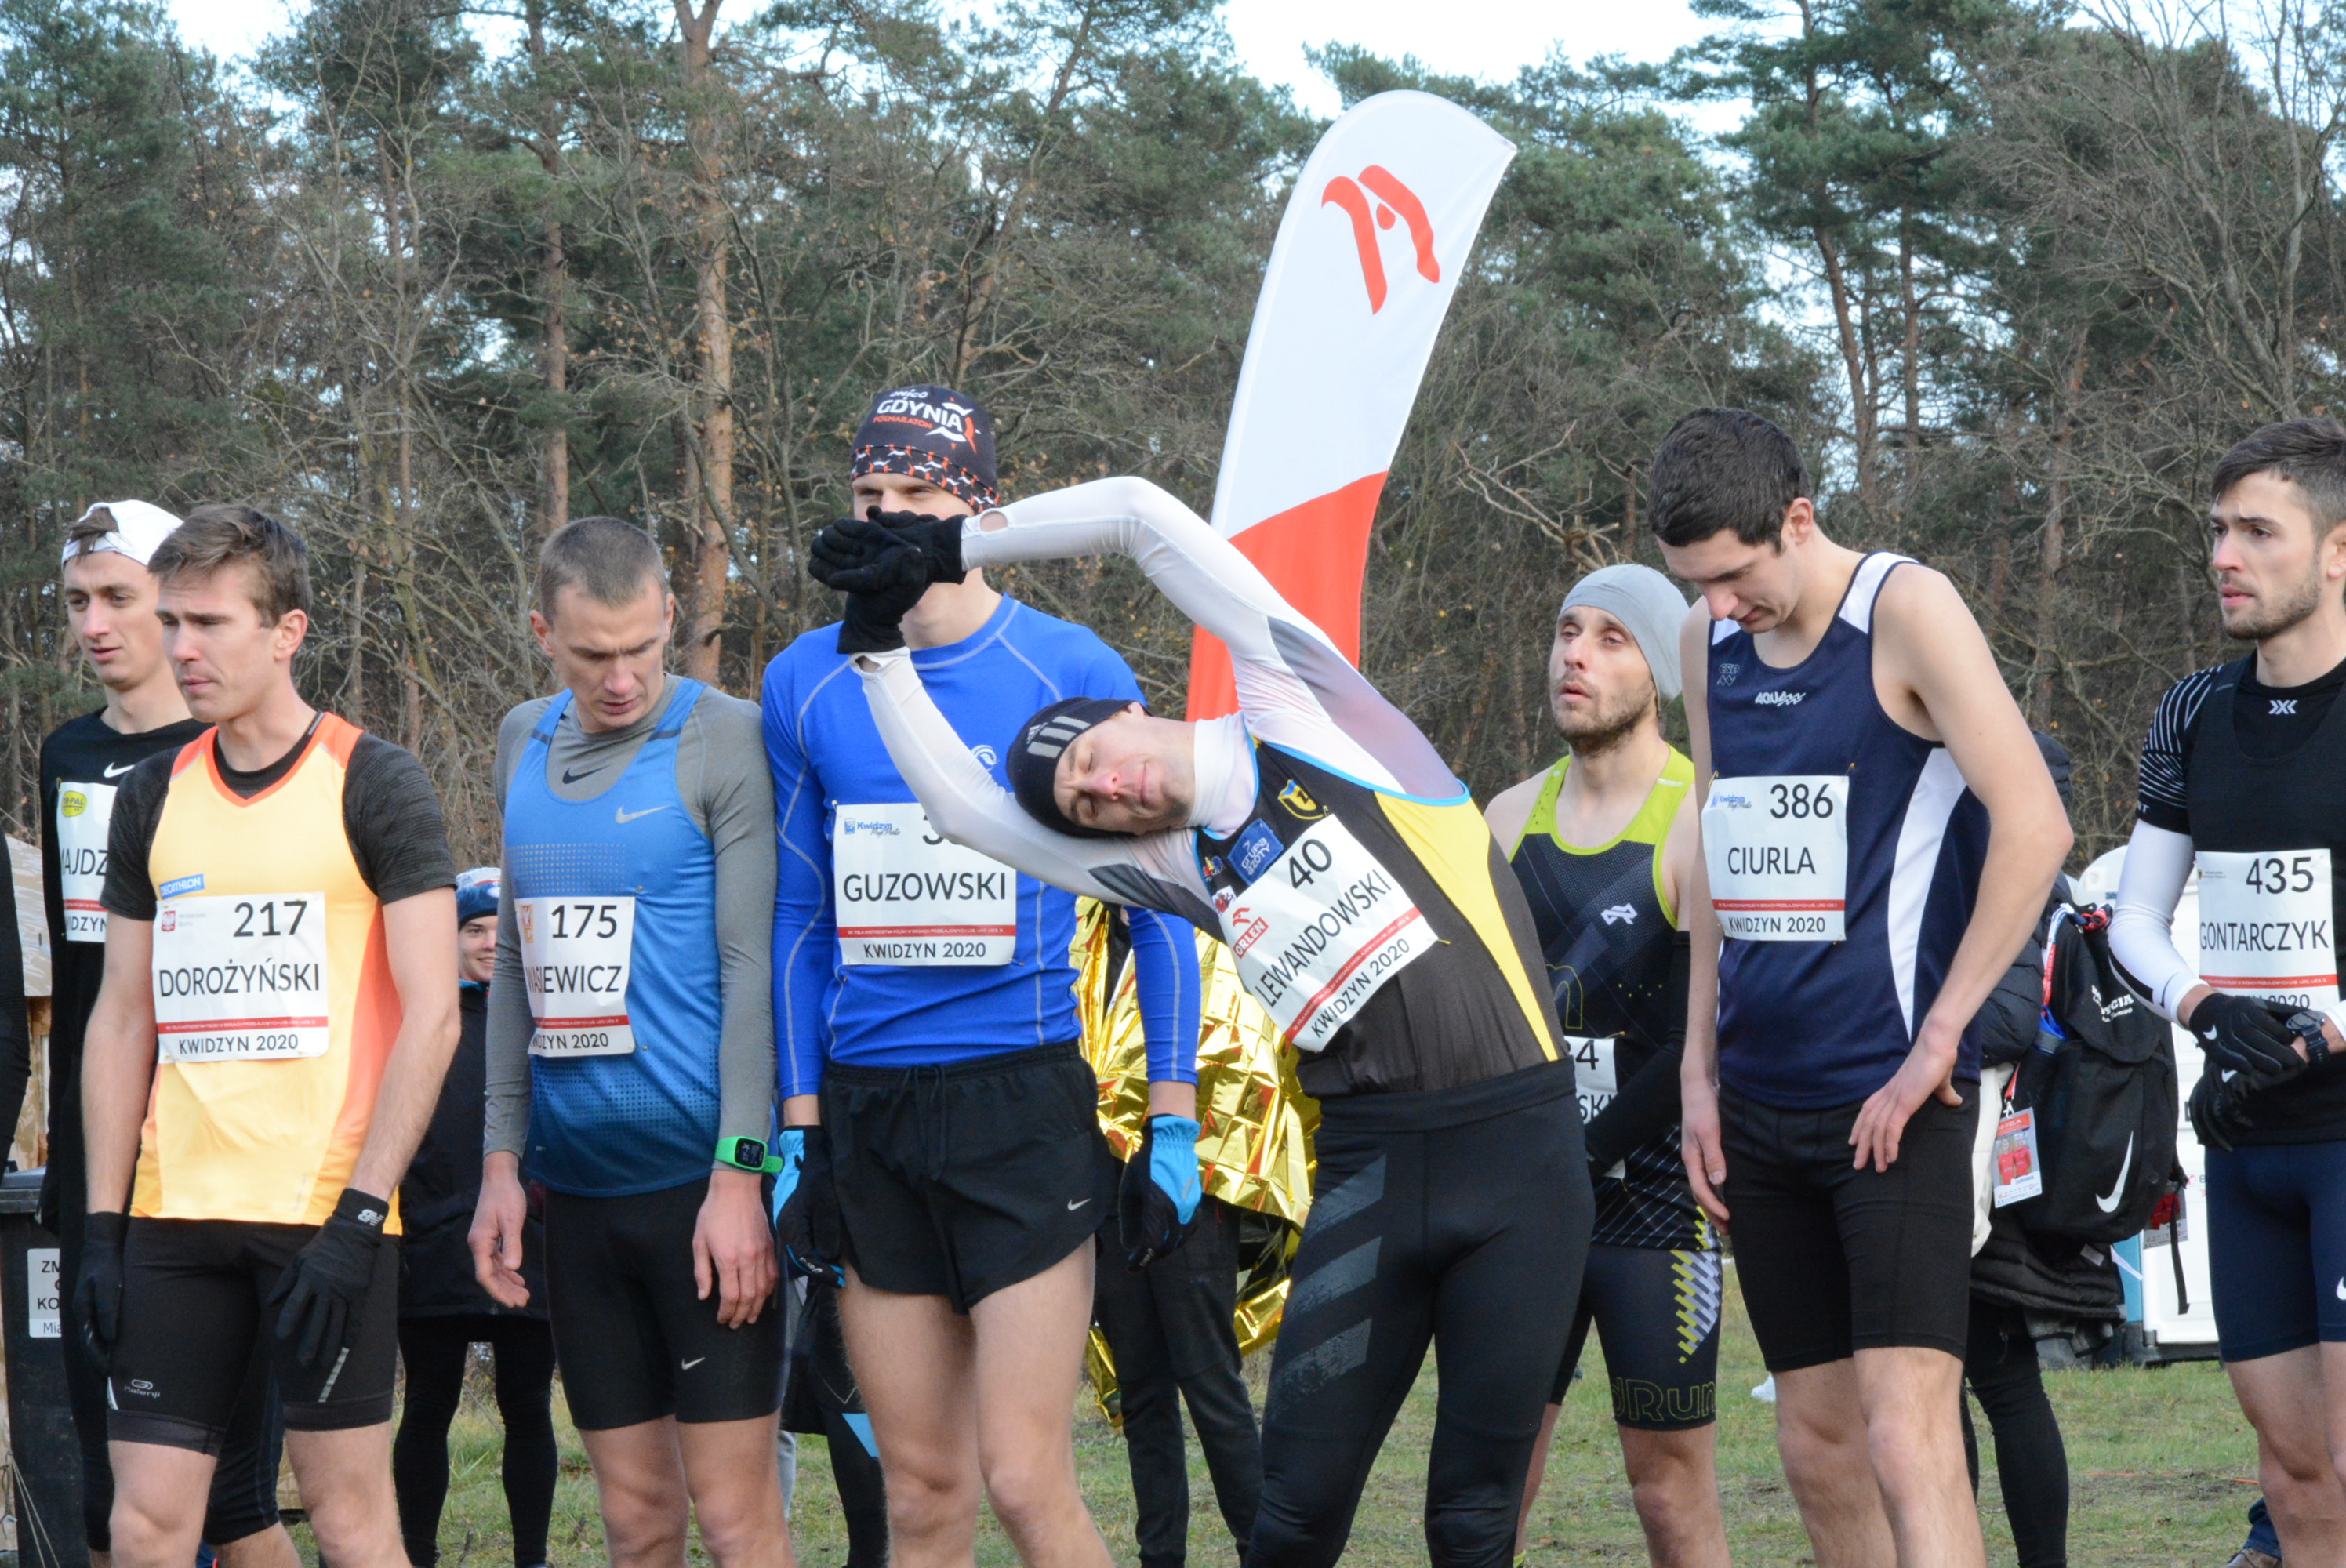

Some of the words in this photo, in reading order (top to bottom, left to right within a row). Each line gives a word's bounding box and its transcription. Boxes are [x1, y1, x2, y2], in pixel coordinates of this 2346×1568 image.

[877, 399, 963, 433] GDYNIA
[1770, 783, 1833, 819] 386
[1288, 839, 1333, 890] 40
[1727, 847, 1816, 875] CIURLA
[2246, 856, 2315, 895] 435
[844, 872, 1006, 902] GUZOWSKI
[233, 900, 307, 938] 217
[551, 905, 618, 938] 175
[1728, 917, 1781, 933] KWIDZYN
[1786, 916, 1826, 933] 2020
[2200, 920, 2330, 952] GONTARCZYK
[863, 943, 936, 959] KWIDZYN
[942, 942, 986, 957] 2020
[1234, 919, 1267, 956] ORLEN
[1255, 869, 1392, 1007] LEWANDOWSKI
[159, 957, 320, 997] DOROŻYŃSKI
[1311, 971, 1371, 1038] KWIDZYN
[1369, 938, 1410, 977] 2020
[179, 1036, 249, 1054] KWIDZYN
[256, 1033, 299, 1051] 2020
[572, 1033, 608, 1049] 2020
